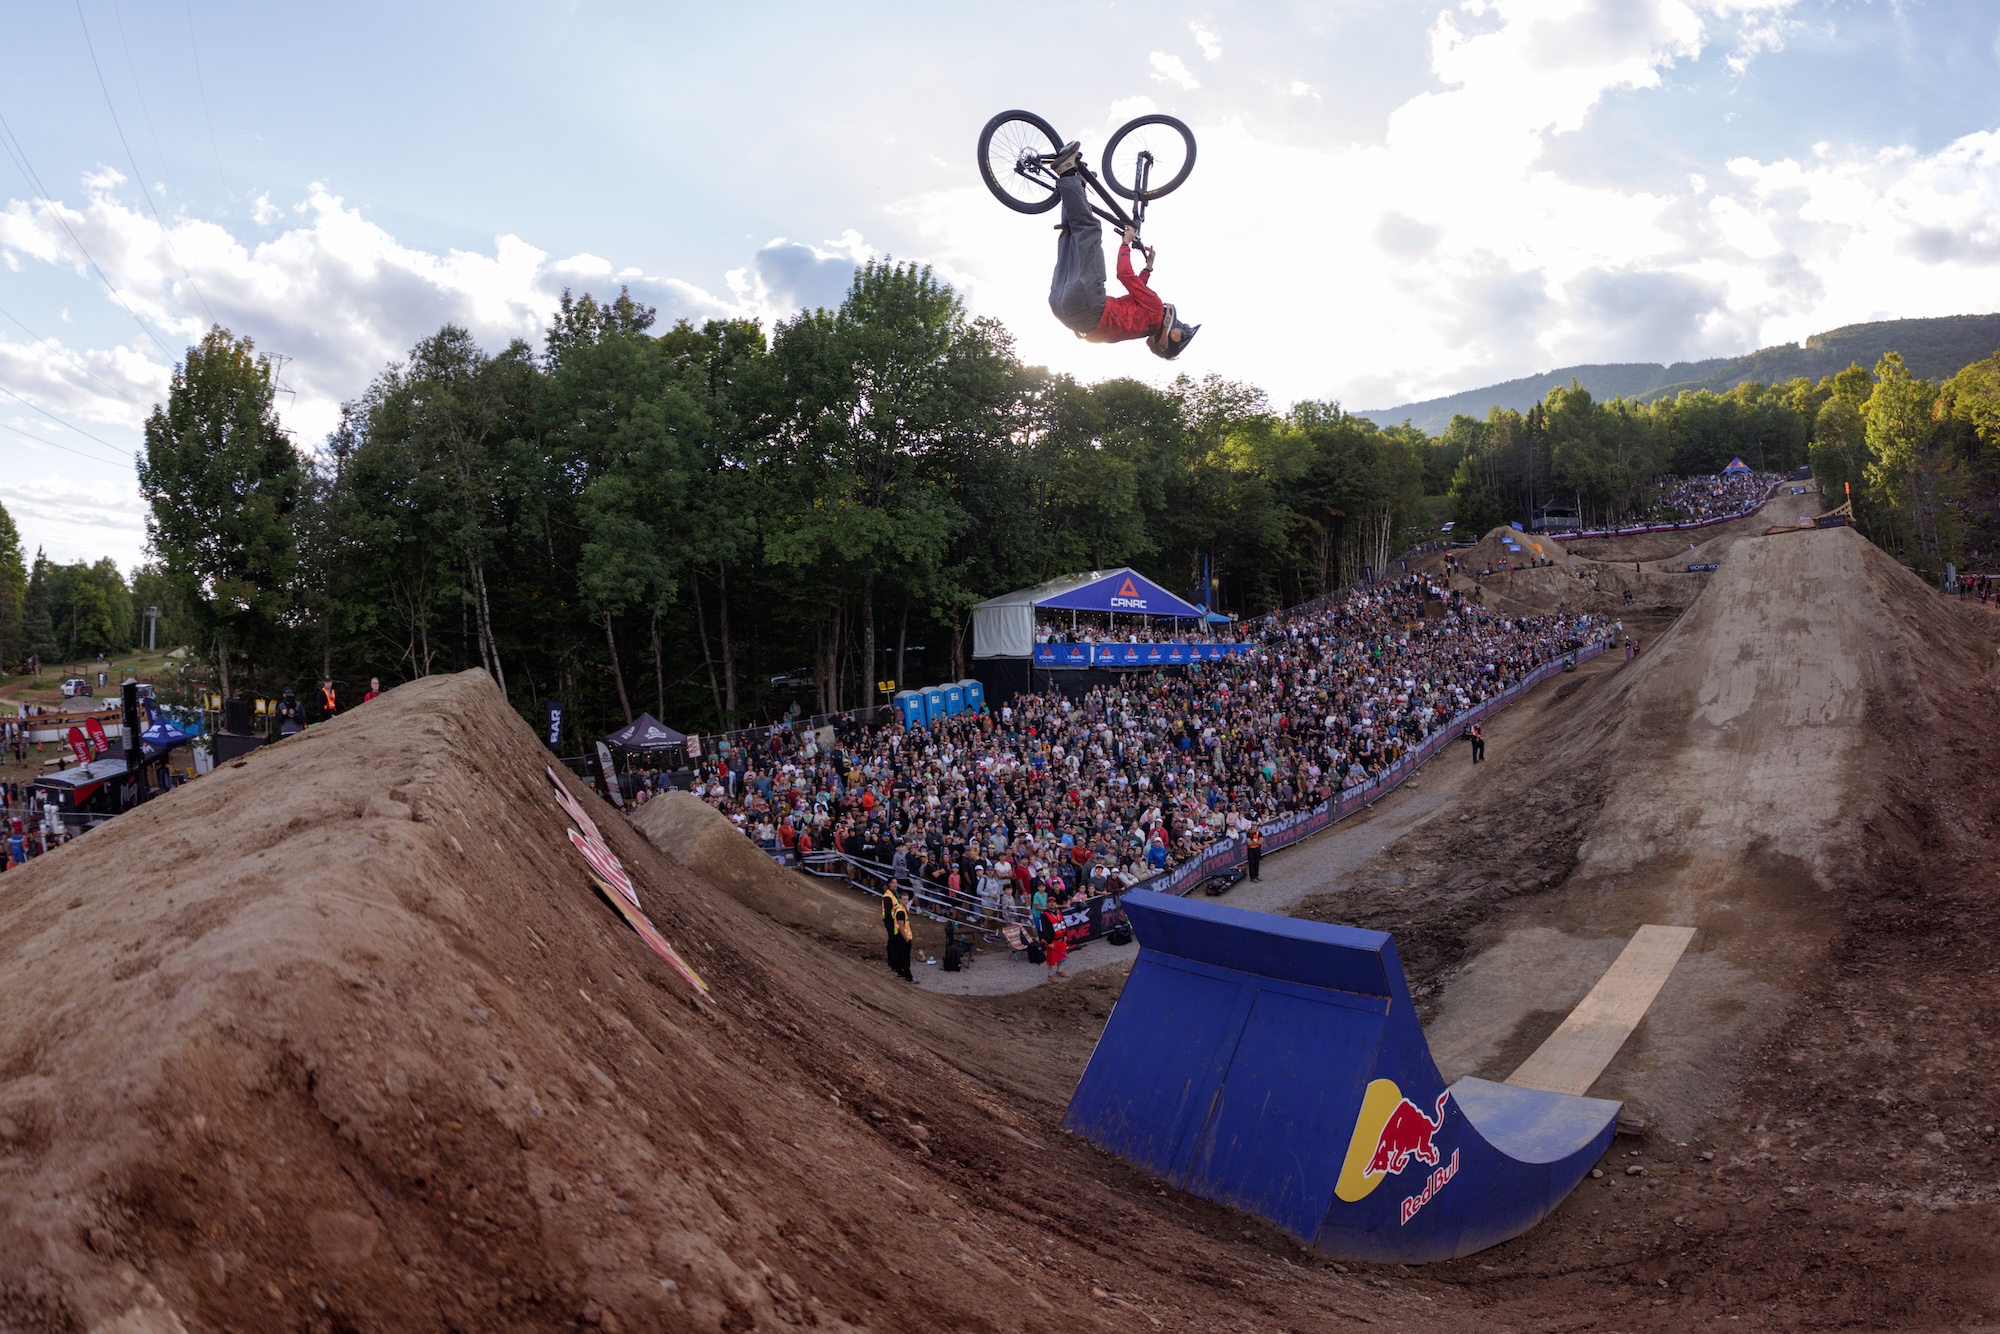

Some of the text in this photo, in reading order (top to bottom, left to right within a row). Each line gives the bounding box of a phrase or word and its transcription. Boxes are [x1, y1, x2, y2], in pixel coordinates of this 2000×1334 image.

[1110, 597, 1147, 609] CANAC
[550, 709, 561, 743] BAR
[1401, 1147, 1460, 1227] Red Bull
